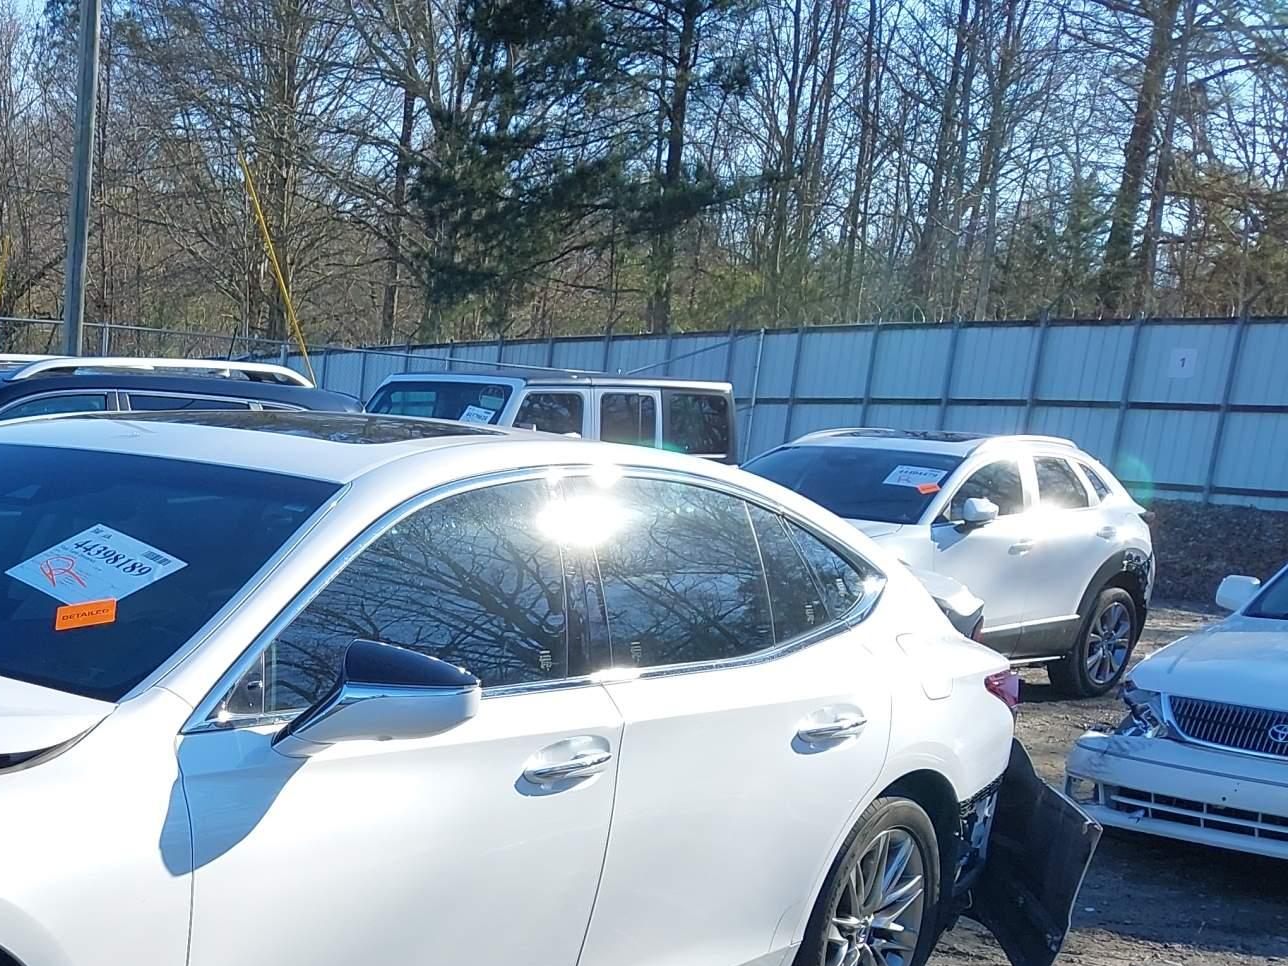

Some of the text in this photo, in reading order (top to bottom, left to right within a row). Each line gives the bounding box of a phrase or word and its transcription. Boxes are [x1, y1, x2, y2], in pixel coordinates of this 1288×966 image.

[1179, 357, 1186, 368] 1
[73, 539, 153, 577] 44398189
[40, 556, 88, 588] R
[62, 608, 109, 621] DETAILED
